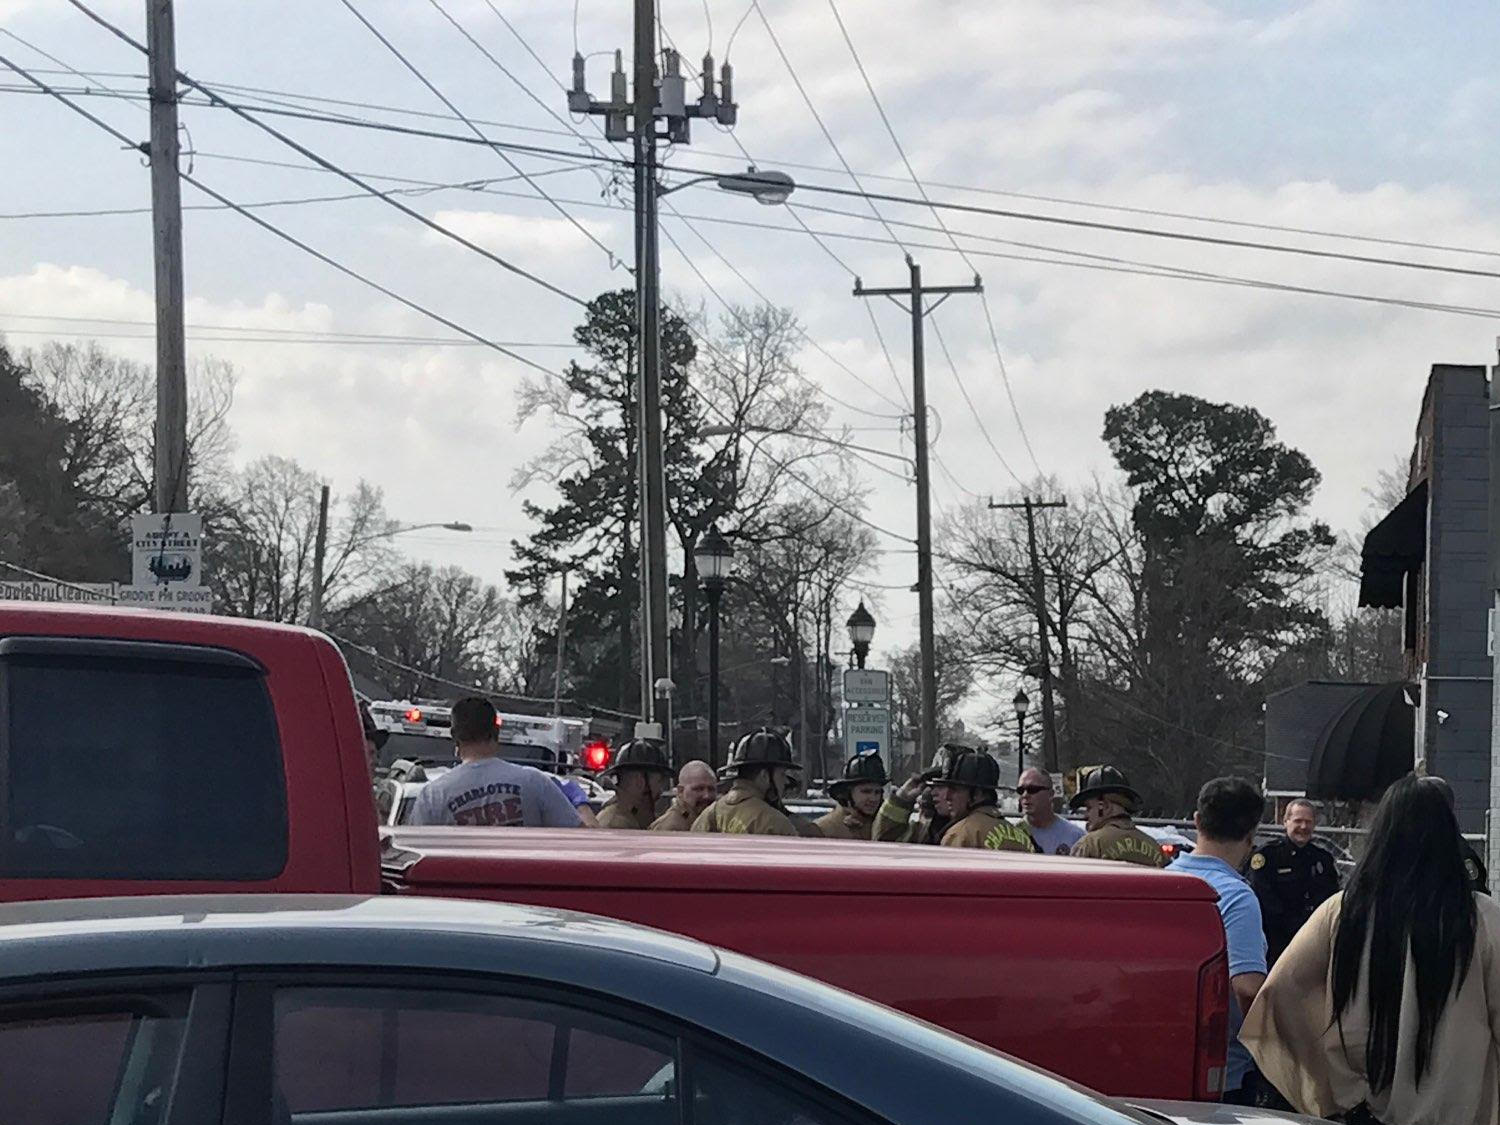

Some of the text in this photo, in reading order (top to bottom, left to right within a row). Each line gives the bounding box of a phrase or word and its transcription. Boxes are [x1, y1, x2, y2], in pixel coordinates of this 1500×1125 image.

[176, 590, 212, 602] GROOVE
[851, 725, 884, 734] PARKING
[449, 783, 521, 812] CHARLOTTE
[452, 798, 524, 826] FIRE
